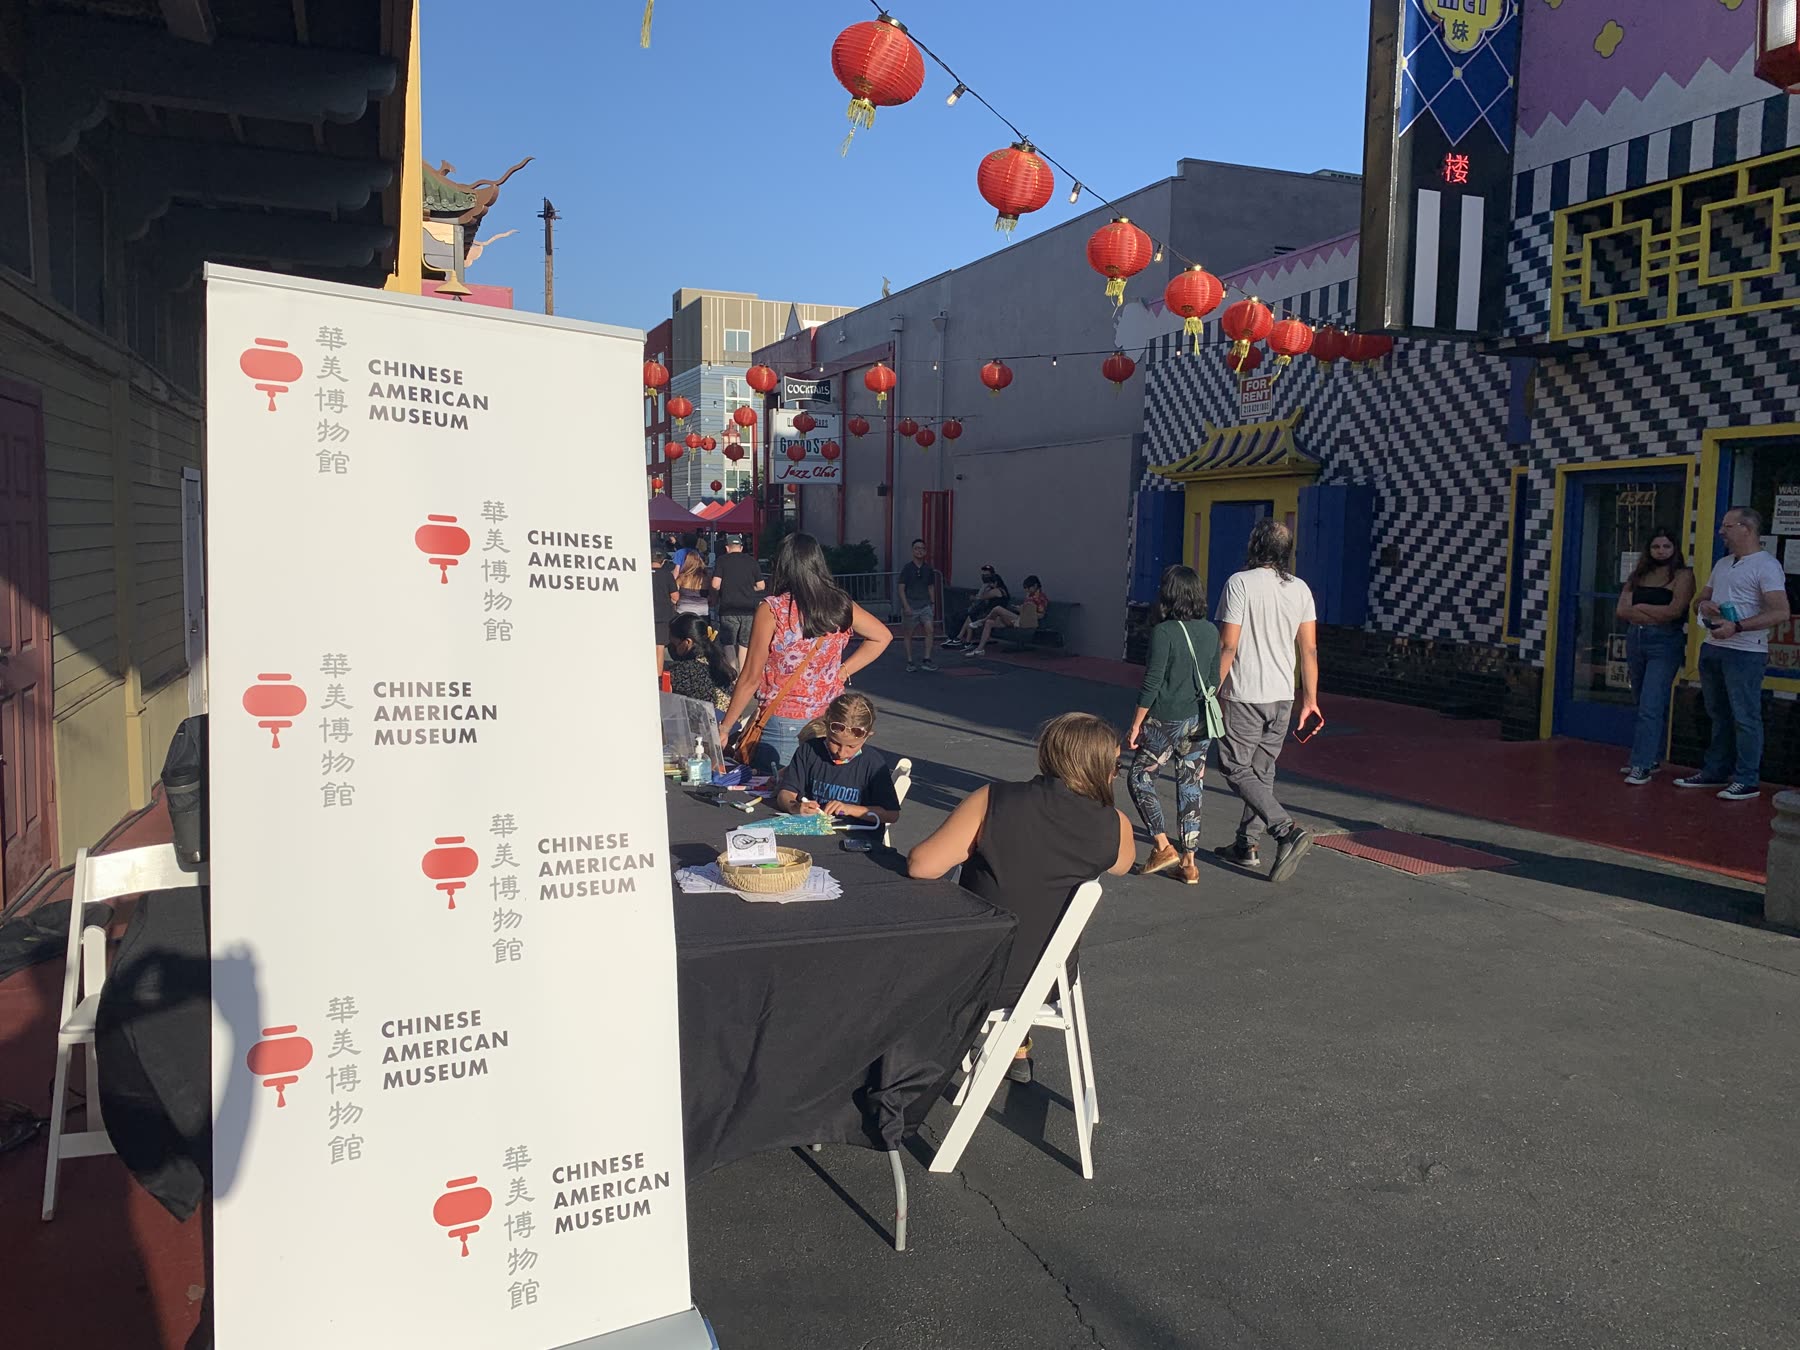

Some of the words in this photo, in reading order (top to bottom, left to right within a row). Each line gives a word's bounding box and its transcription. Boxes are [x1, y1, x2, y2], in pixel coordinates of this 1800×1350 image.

[1452, 19, 1469, 43] 妹
[1446, 152, 1469, 184] 楼
[368, 359, 463, 385] CHINESE
[368, 382, 488, 410] AMERICAN
[787, 384, 830, 395] COCKTAILS
[1243, 390, 1269, 403] RENT
[1247, 379, 1267, 392] FOR
[315, 326, 350, 474] 華美博物館
[369, 405, 468, 430] MUSEUM
[777, 465, 811, 480] Jazz
[812, 465, 839, 479] Club
[1778, 486, 1800, 495] WAR
[528, 530, 613, 549] CHINESE
[481, 500, 513, 641] 華美博物館
[528, 552, 636, 573] AMERICAN
[529, 574, 619, 592] MUSEUM
[374, 682, 471, 699] CHINESE
[374, 704, 497, 722] AMERICAN
[319, 653, 356, 807] 華美博物館
[374, 728, 477, 746] MUSEUM
[538, 833, 629, 855] CHINESE
[539, 853, 655, 878] AMERICAN
[489, 814, 523, 963] 華美博物館
[540, 876, 637, 901] MUSEUM
[381, 1010, 481, 1039] CHINESE
[382, 1030, 509, 1065] AMERICAN
[326, 996, 364, 1164] 華美博物館
[383, 1058, 489, 1091] MUSEUM
[552, 1152, 645, 1185] CHINESE
[553, 1171, 670, 1210] AMERICAN
[503, 1145, 540, 1310] 華美博物館
[555, 1199, 652, 1235] MUSEUM
